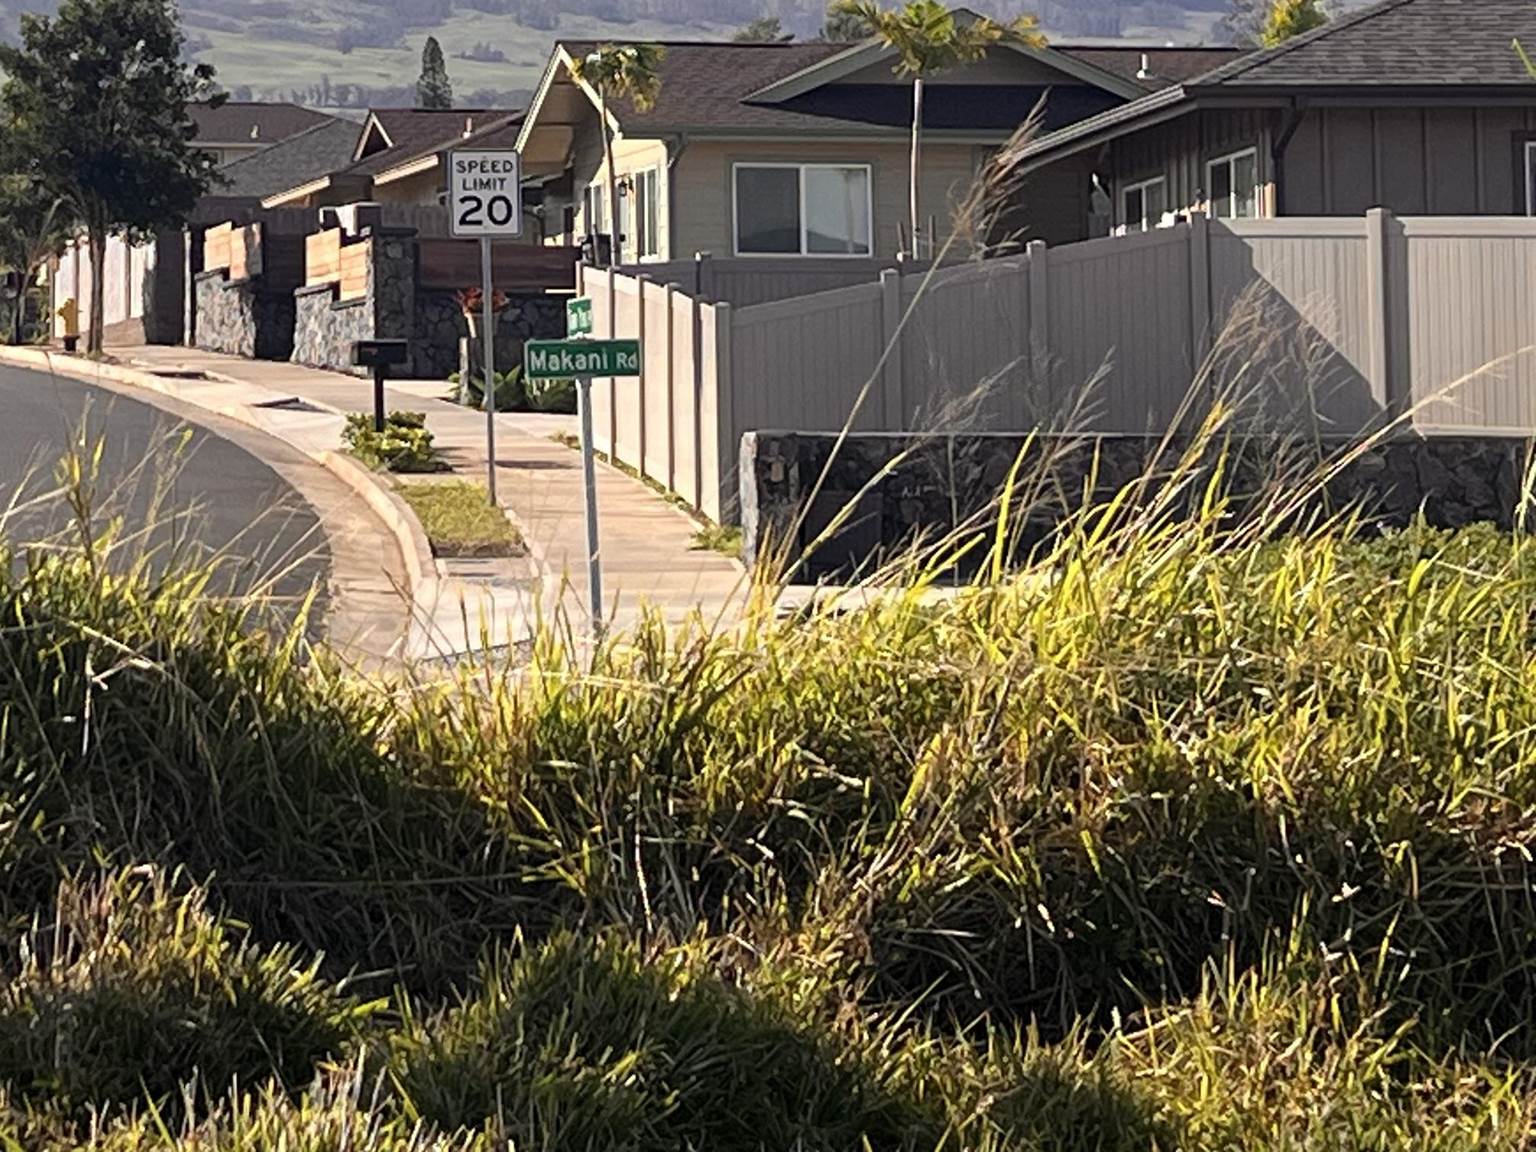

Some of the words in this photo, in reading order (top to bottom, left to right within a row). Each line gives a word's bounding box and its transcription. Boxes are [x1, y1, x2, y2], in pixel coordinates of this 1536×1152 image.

[455, 159, 513, 174] SPEED
[462, 177, 507, 191] LIMIT
[458, 195, 513, 226] 20
[530, 348, 609, 371] Makani
[615, 351, 638, 369] Rd
